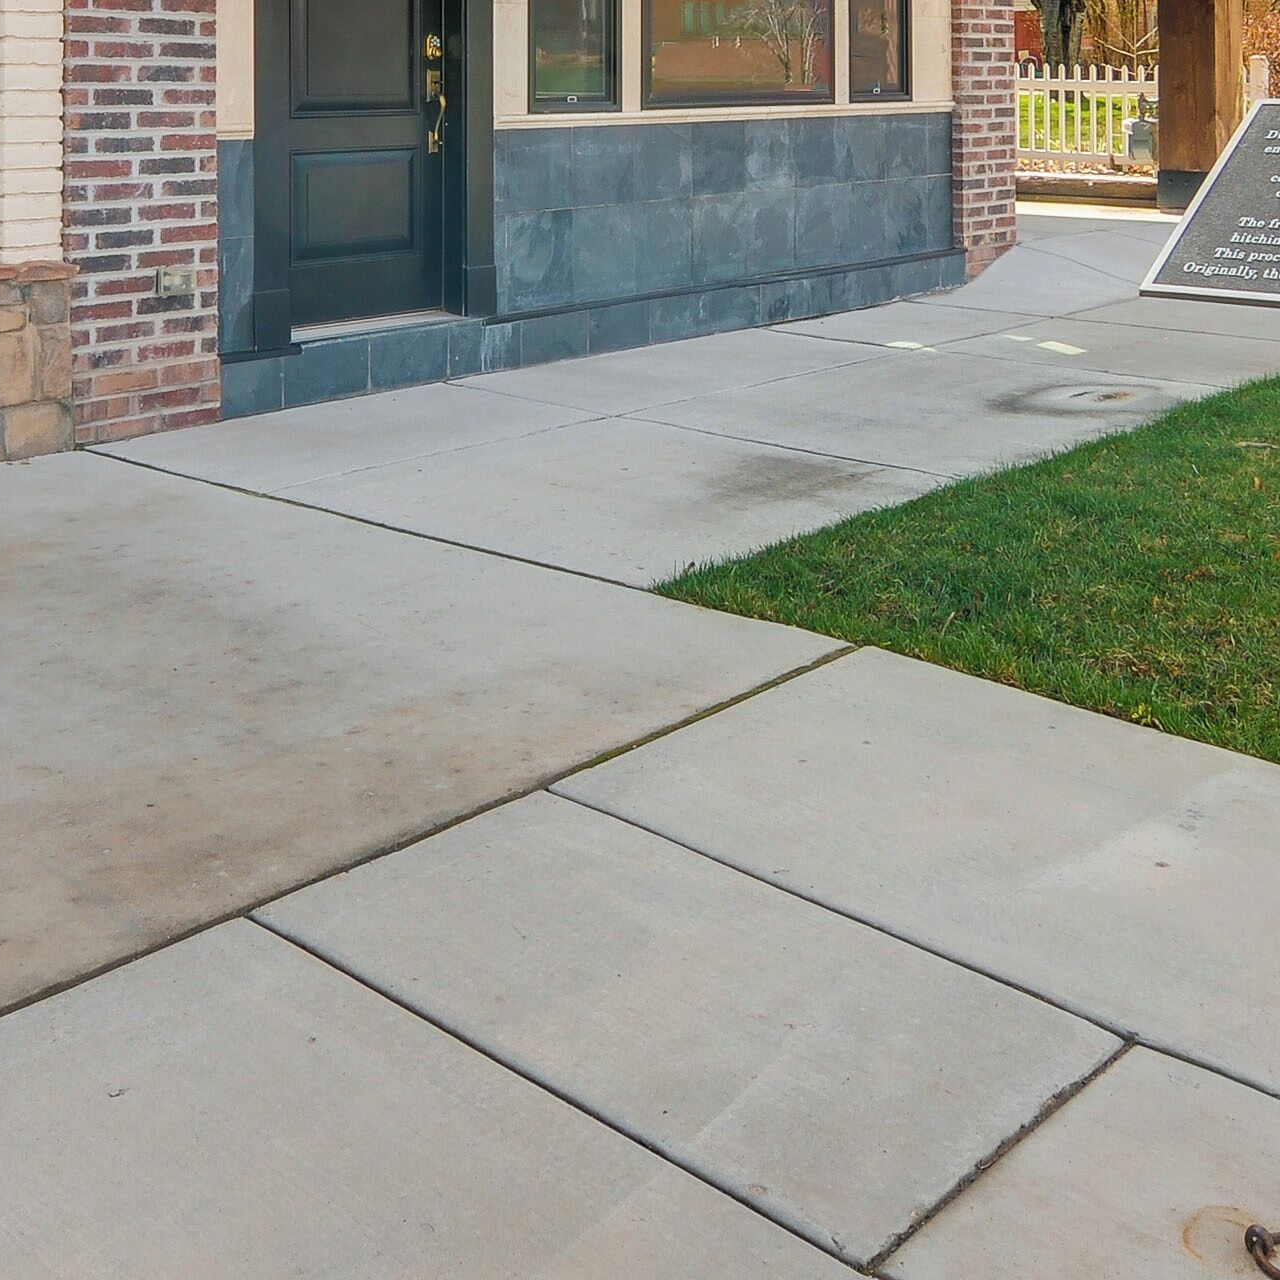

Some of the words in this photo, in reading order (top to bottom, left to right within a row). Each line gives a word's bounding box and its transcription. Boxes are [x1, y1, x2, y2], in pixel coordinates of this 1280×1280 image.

[1238, 217, 1266, 228] The
[1213, 247, 1246, 259] This
[1183, 261, 1259, 280] Originally,
